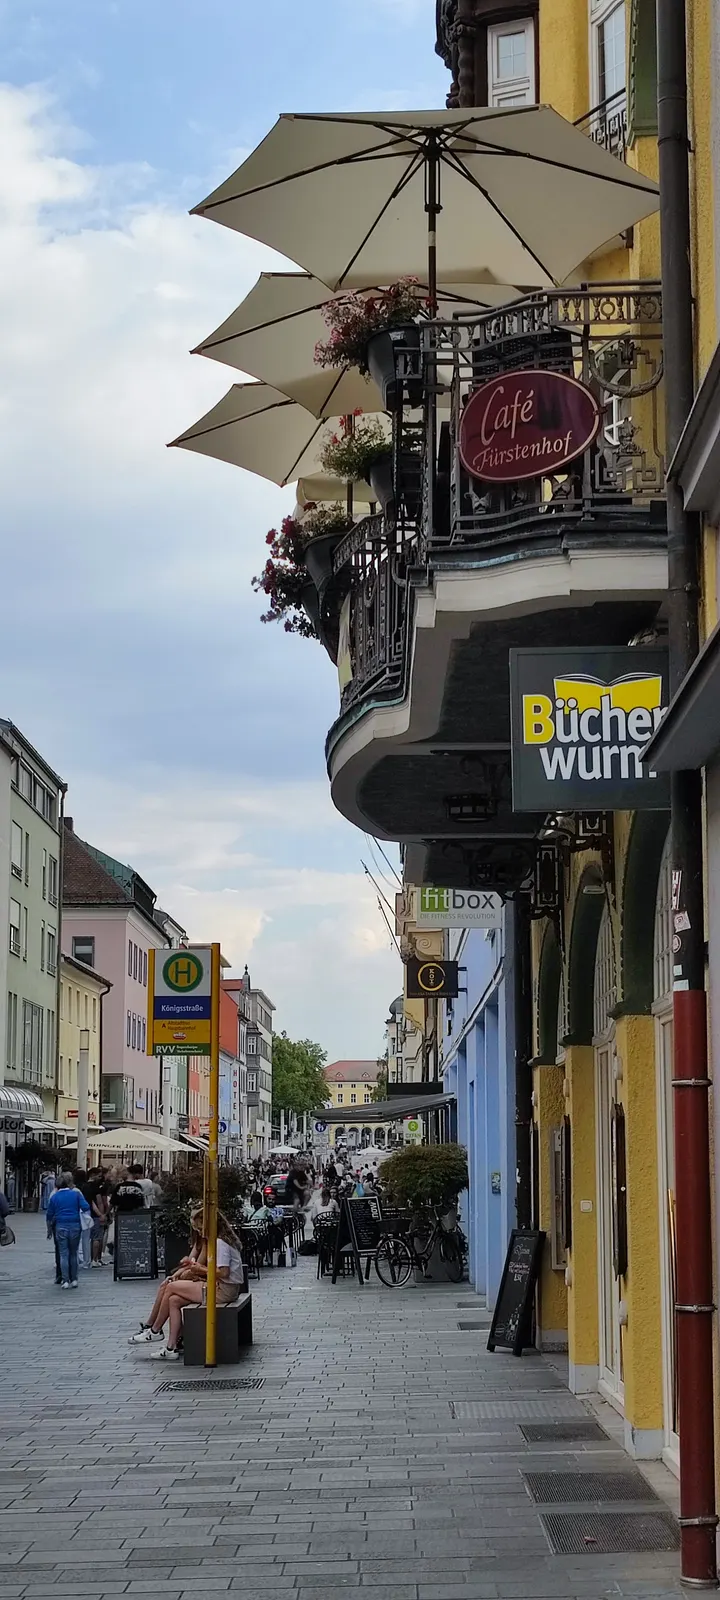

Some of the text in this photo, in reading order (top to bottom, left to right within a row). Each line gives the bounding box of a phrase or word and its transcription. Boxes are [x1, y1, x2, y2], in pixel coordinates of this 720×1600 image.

[480, 385, 534, 446] Café
[472, 430, 573, 472] Fürstenhof
[522, 693, 669, 745] Bücher
[422, 887, 496, 910] fitbox
[175, 961, 191, 984] H
[161, 1004, 204, 1014] Königsstraße
[155, 1045, 176, 1054] RVV
